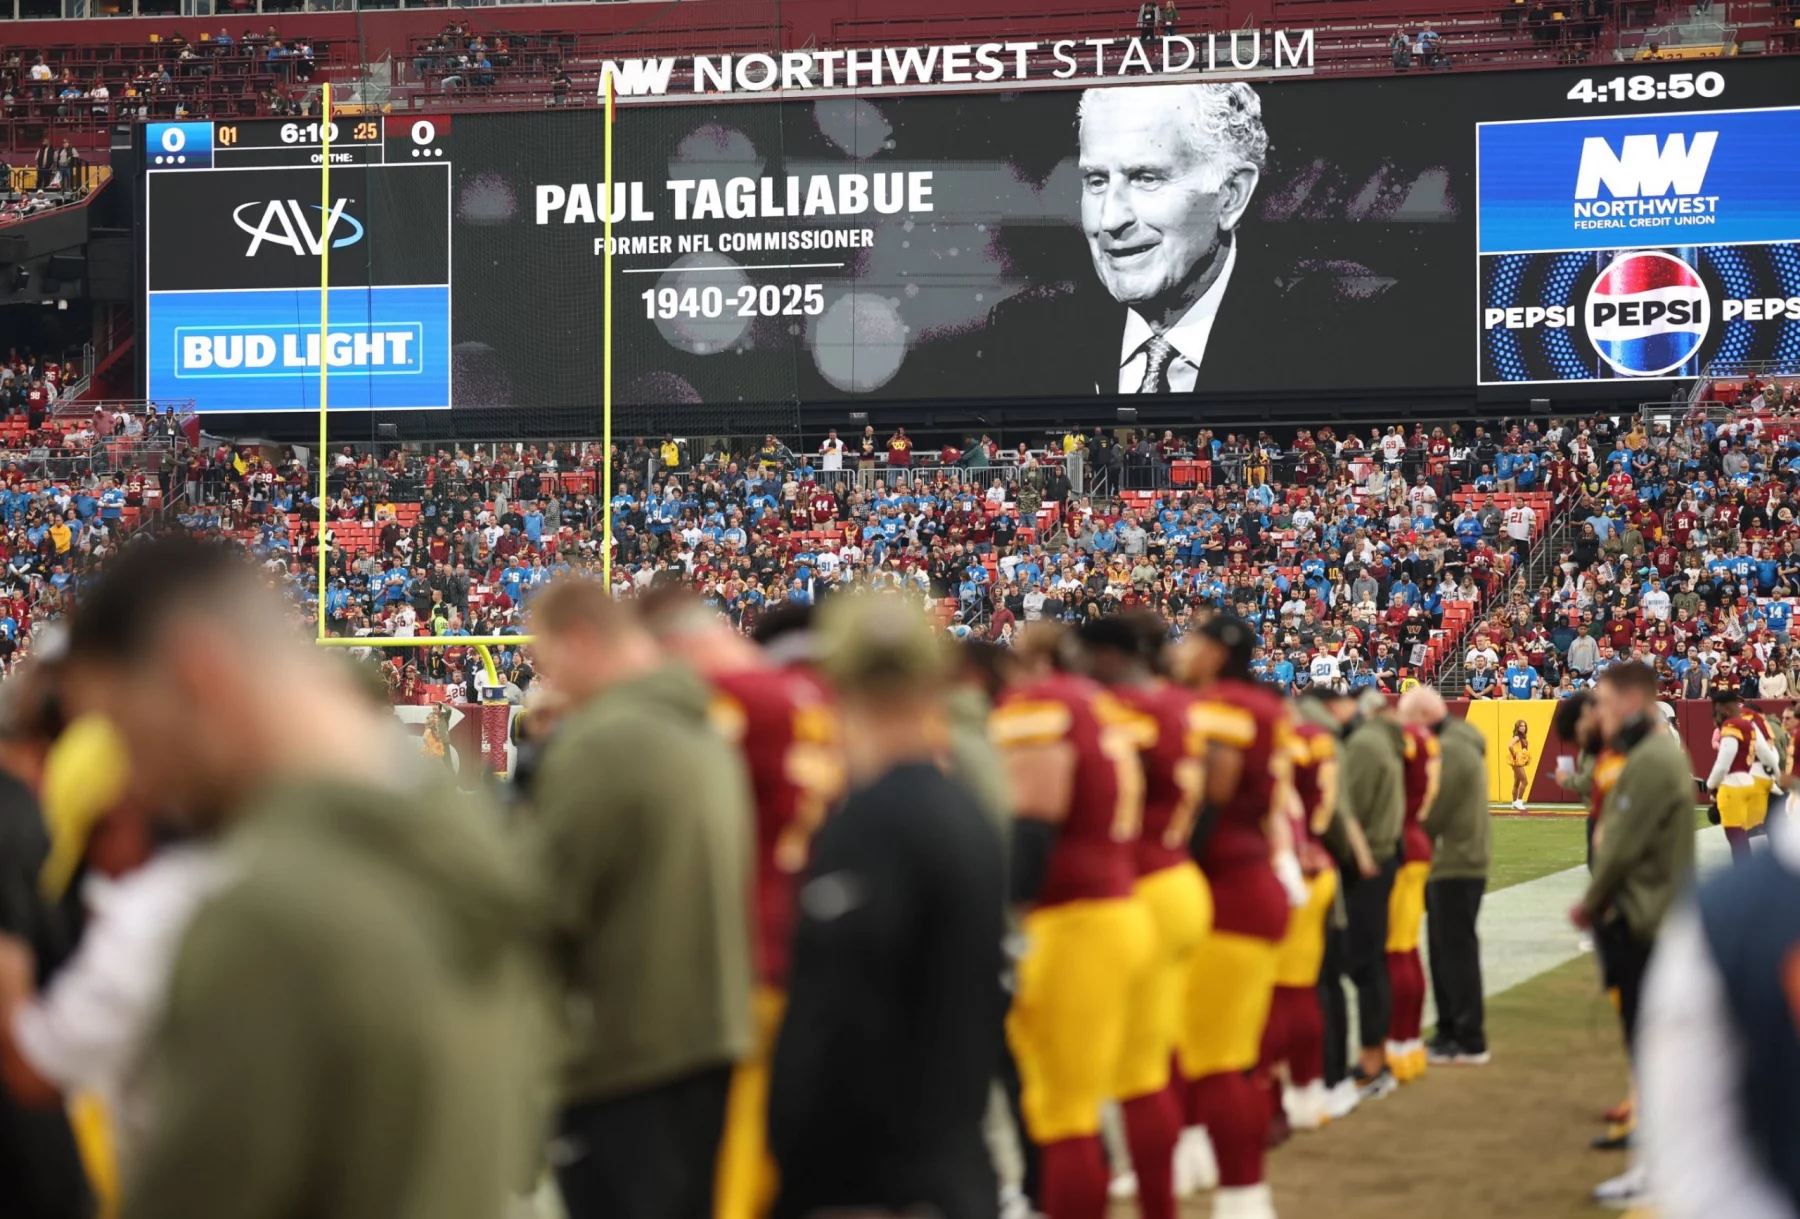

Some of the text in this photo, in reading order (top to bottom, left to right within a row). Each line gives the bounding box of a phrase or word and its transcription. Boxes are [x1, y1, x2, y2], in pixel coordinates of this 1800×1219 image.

[597, 29, 1314, 96] NW NORTHWEST STADIUM
[1567, 71, 1725, 103] 4:18:50
[219, 122, 377, 146] Q1 6:10 :25
[411, 120, 435, 145] 0
[162, 127, 186, 152] 0
[1574, 131, 1719, 199] NW
[536, 171, 934, 224] PAUL TAGLIABUE
[1574, 196, 1719, 218] NORTHWEST
[1574, 215, 1715, 230] FEDERAL CREDIT UNION
[678, 234, 713, 253] NFL
[719, 229, 874, 252] COMMISSIONER
[641, 283, 825, 320] 1940-2025
[1485, 305, 1575, 329] PEPSI
[1593, 300, 1702, 327] PEPSI
[183, 332, 413, 369] BUD LIGHT
[30, 391, 41, 400] 98
[1386, 440, 1396, 449] 59
[1523, 461, 1534, 472] 4
[130, 482, 140, 492] 55
[815, 500, 829, 511] 44
[962, 502, 971, 511] 18
[1510, 513, 1523, 524] 21
[1678, 518, 1689, 529] 21
[885, 524, 896, 534] 39
[1074, 520, 1079, 530] 5
[488, 534, 495, 544] 5
[843, 553, 854, 565] 91
[1658, 553, 1670, 565] 91
[821, 561, 831, 572] 91
[1736, 562, 1748, 574] 16
[1328, 568, 1339, 580] 10
[372, 579, 381, 590] 16
[1620, 597, 1627, 608] 5
[1769, 606, 1782, 618] 14
[1406, 625, 1422, 634] W
[1316, 664, 1331, 676] 20
[510, 671, 520, 683] 17
[1512, 674, 1529, 688] 97
[452, 687, 466, 698] 28
